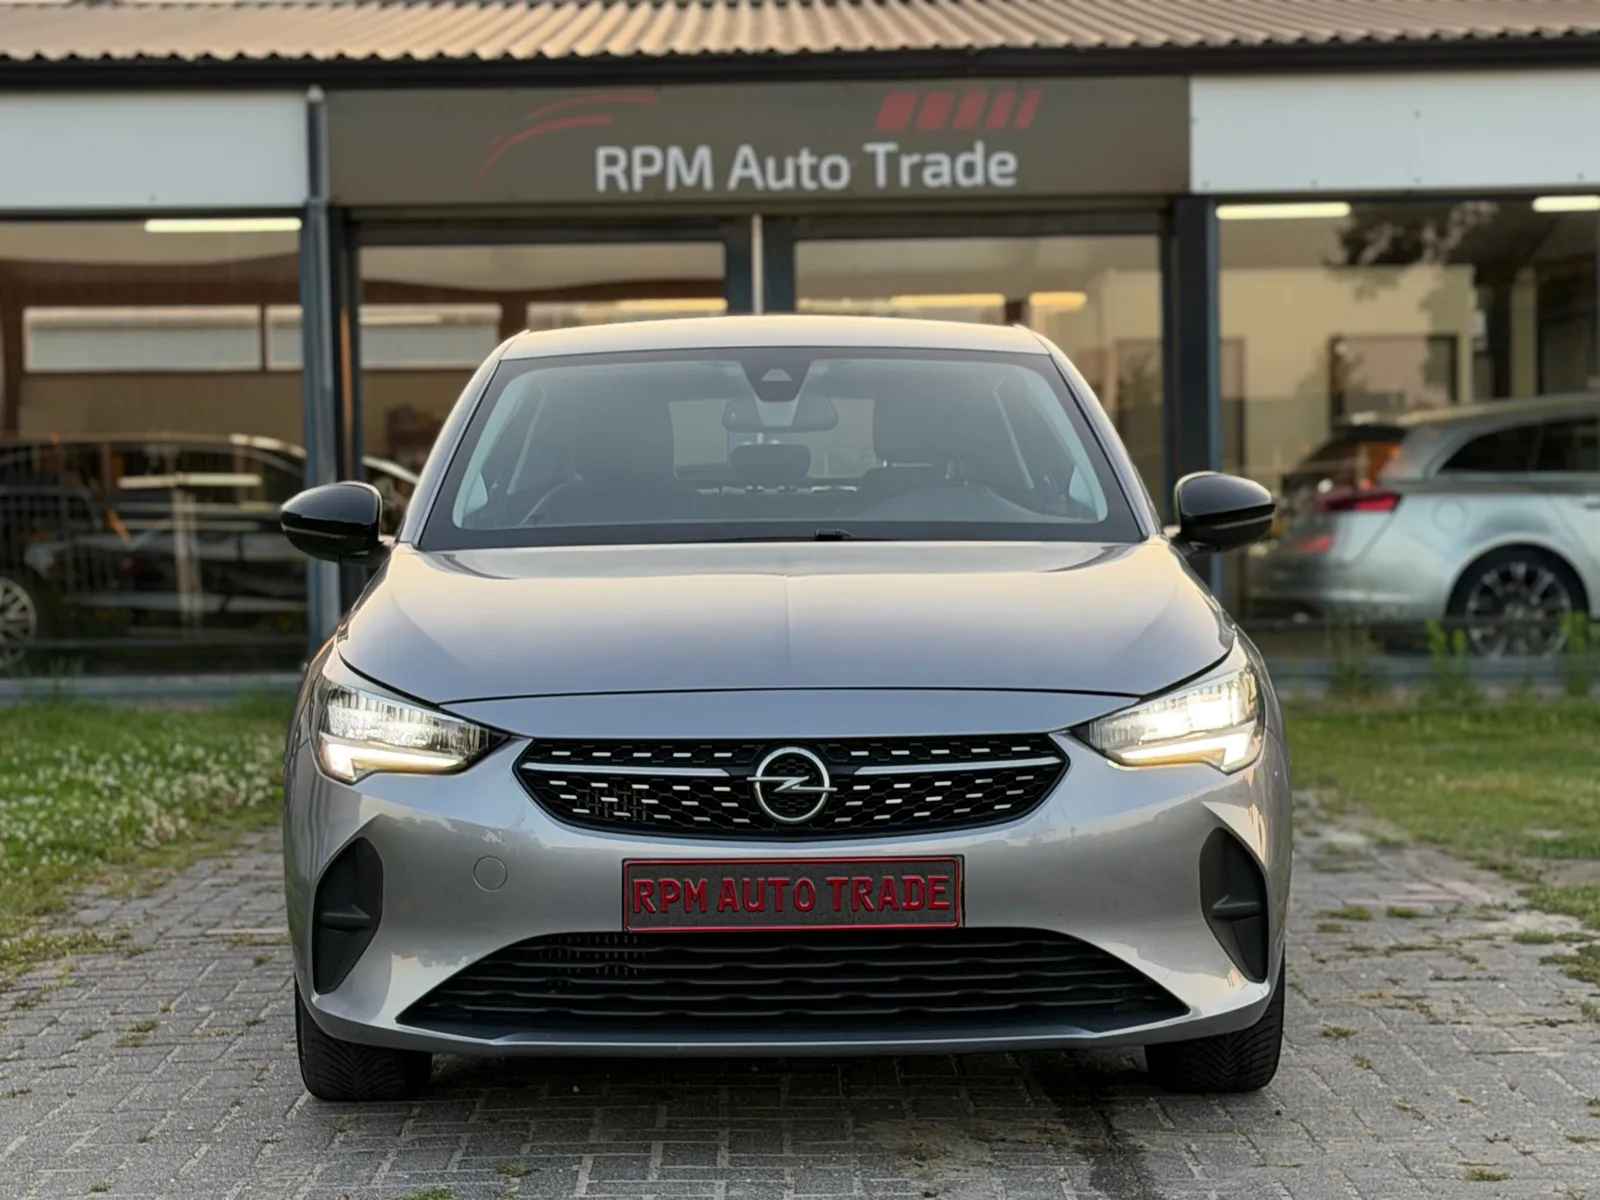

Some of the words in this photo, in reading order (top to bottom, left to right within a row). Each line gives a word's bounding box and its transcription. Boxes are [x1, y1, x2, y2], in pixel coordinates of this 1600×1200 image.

[596, 145, 714, 192] RPM
[728, 144, 851, 190] Auto
[864, 140, 1018, 188] Trade
[632, 878, 708, 913] RPM
[718, 877, 816, 912] AUTO
[826, 875, 951, 911] TRADE
